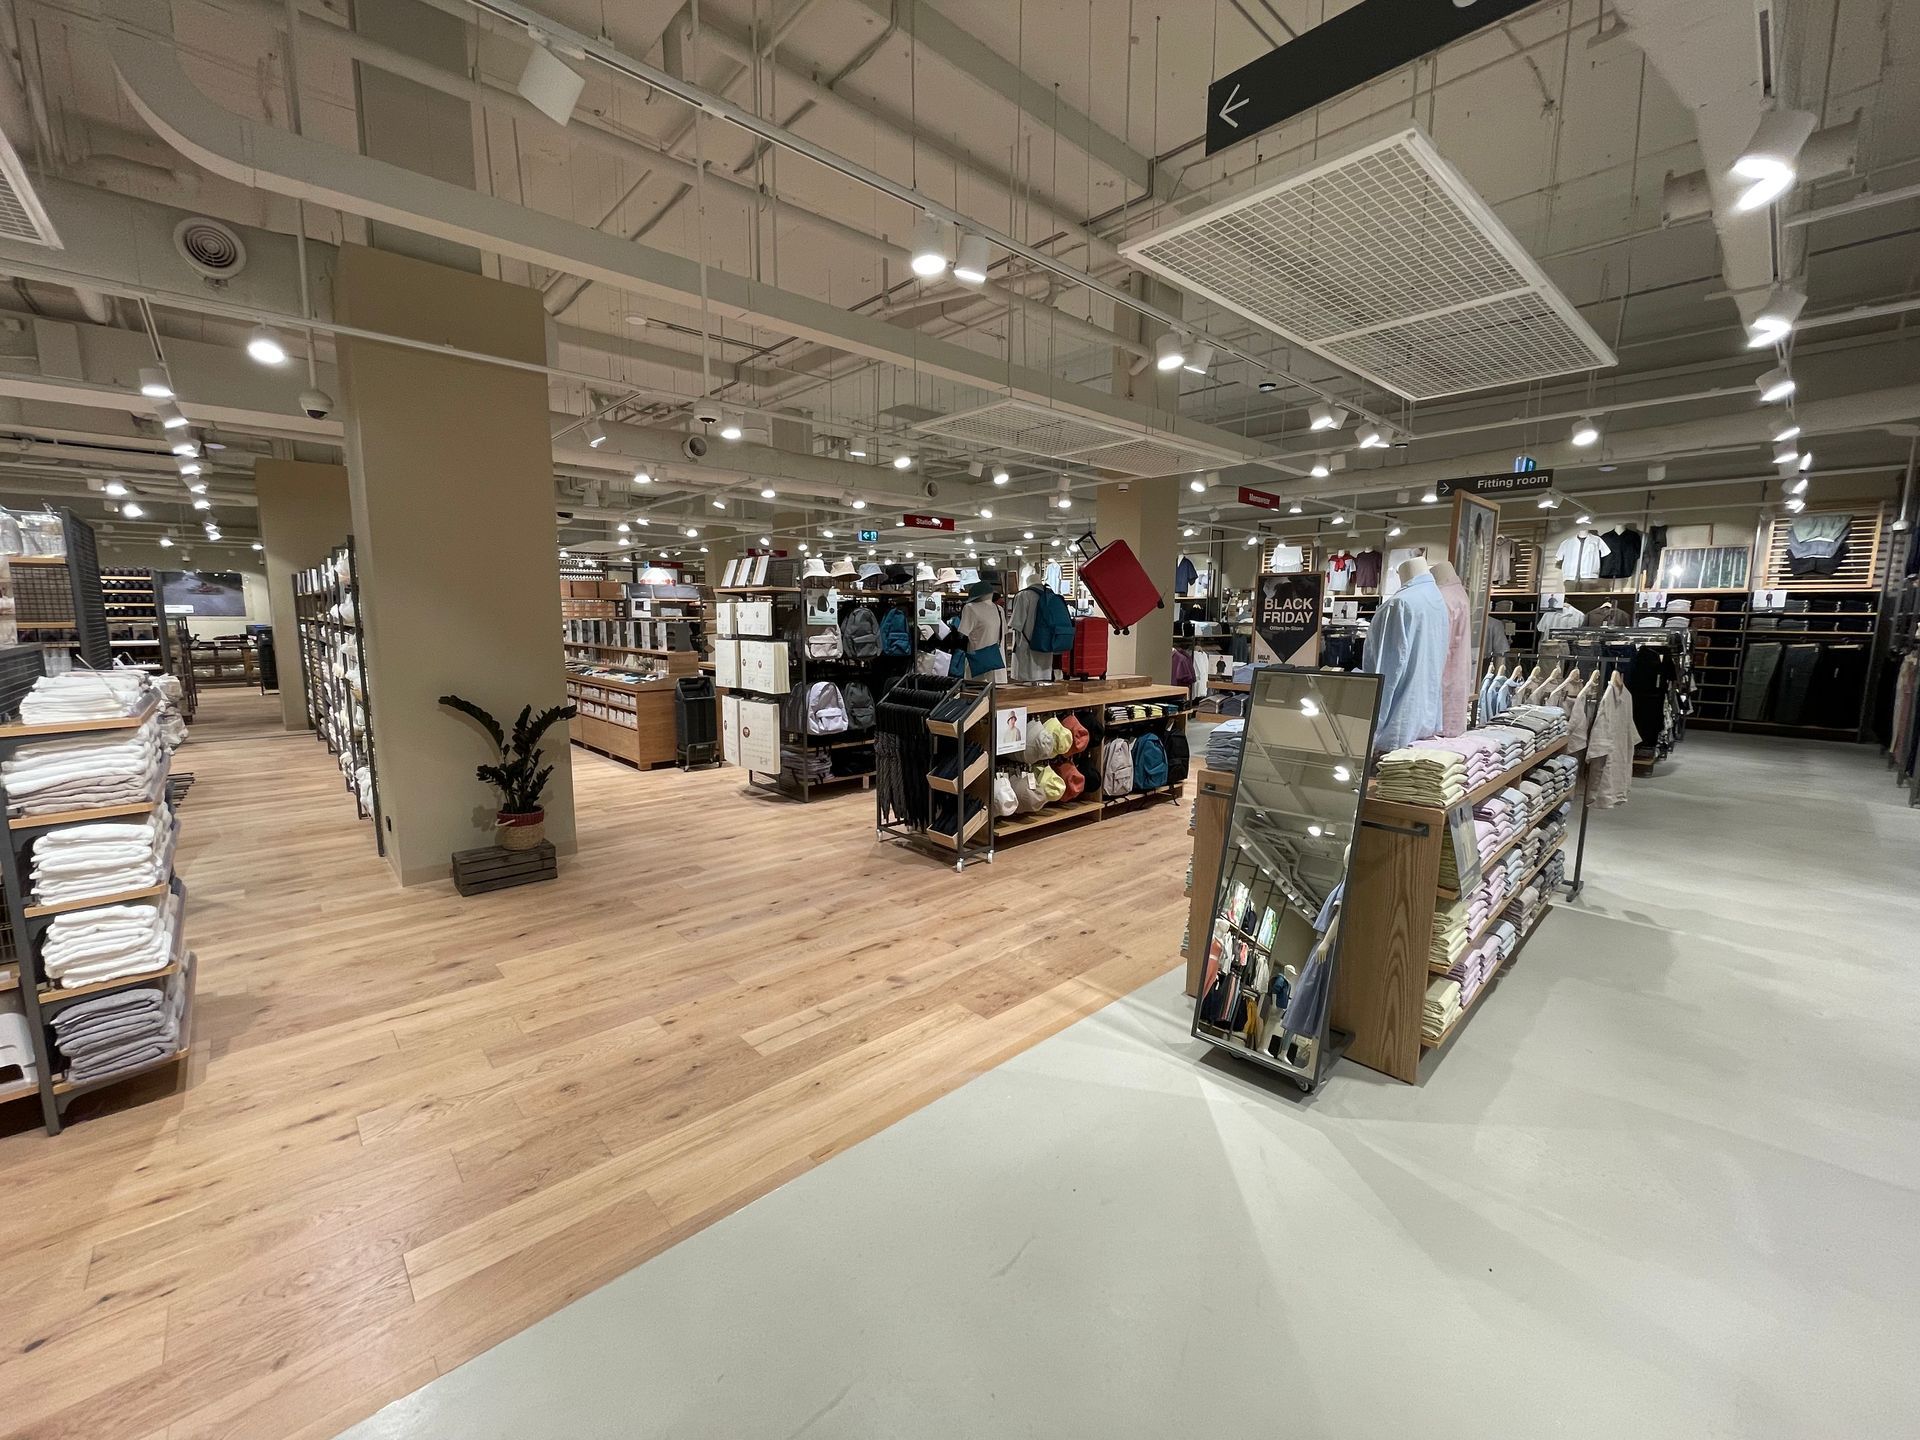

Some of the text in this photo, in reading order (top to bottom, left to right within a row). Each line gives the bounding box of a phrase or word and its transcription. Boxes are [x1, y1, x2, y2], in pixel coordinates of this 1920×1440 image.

[1477, 475, 1549, 489] Fitting room
[1264, 598, 1312, 610] BLACK
[1263, 612, 1313, 623] FRIDAY
